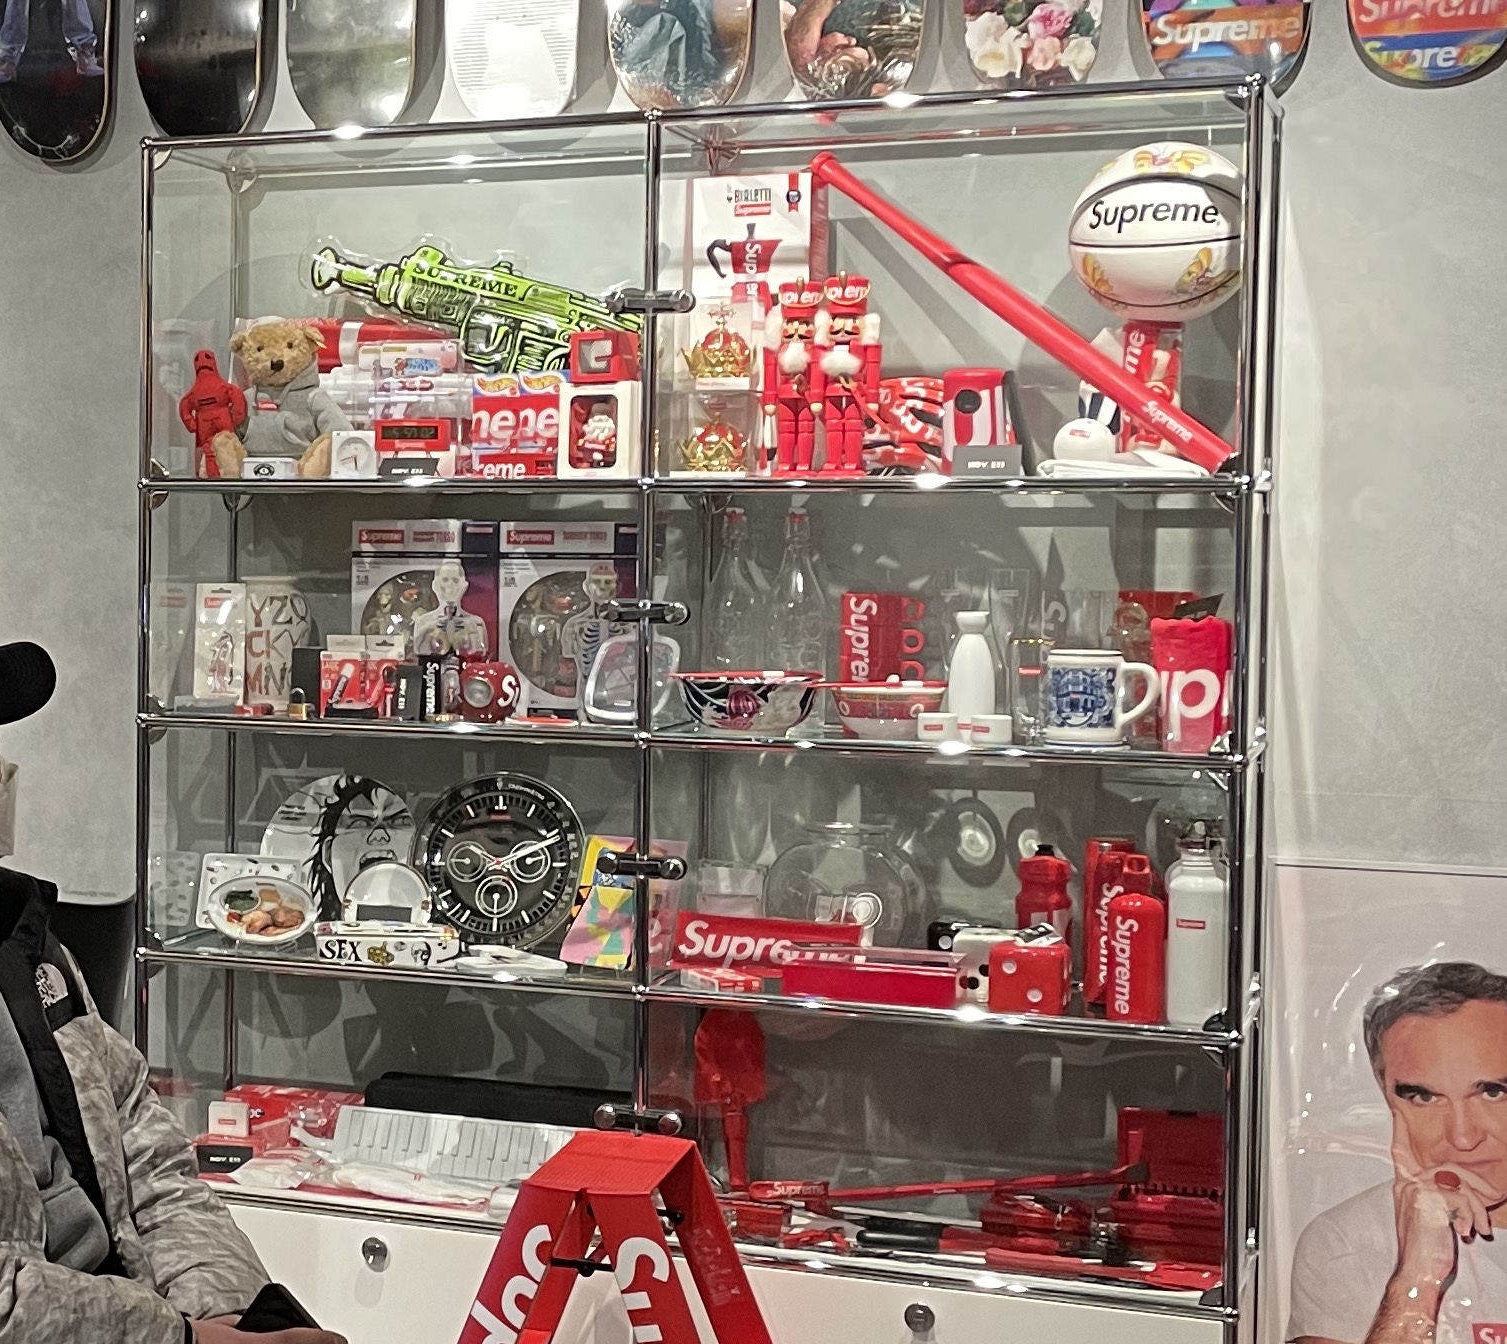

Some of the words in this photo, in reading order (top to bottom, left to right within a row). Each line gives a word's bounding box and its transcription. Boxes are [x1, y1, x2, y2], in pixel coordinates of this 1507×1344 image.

[1152, 12, 1301, 53] Supreme
[1089, 199, 1219, 234] Supreme
[1143, 399, 1193, 443] Supreme
[360, 530, 403, 544] Supreme
[508, 531, 554, 544] Supreme
[422, 661, 439, 717] Supreme
[1110, 914, 1140, 1015] Supreme
[765, 1181, 825, 1199] Supreme
